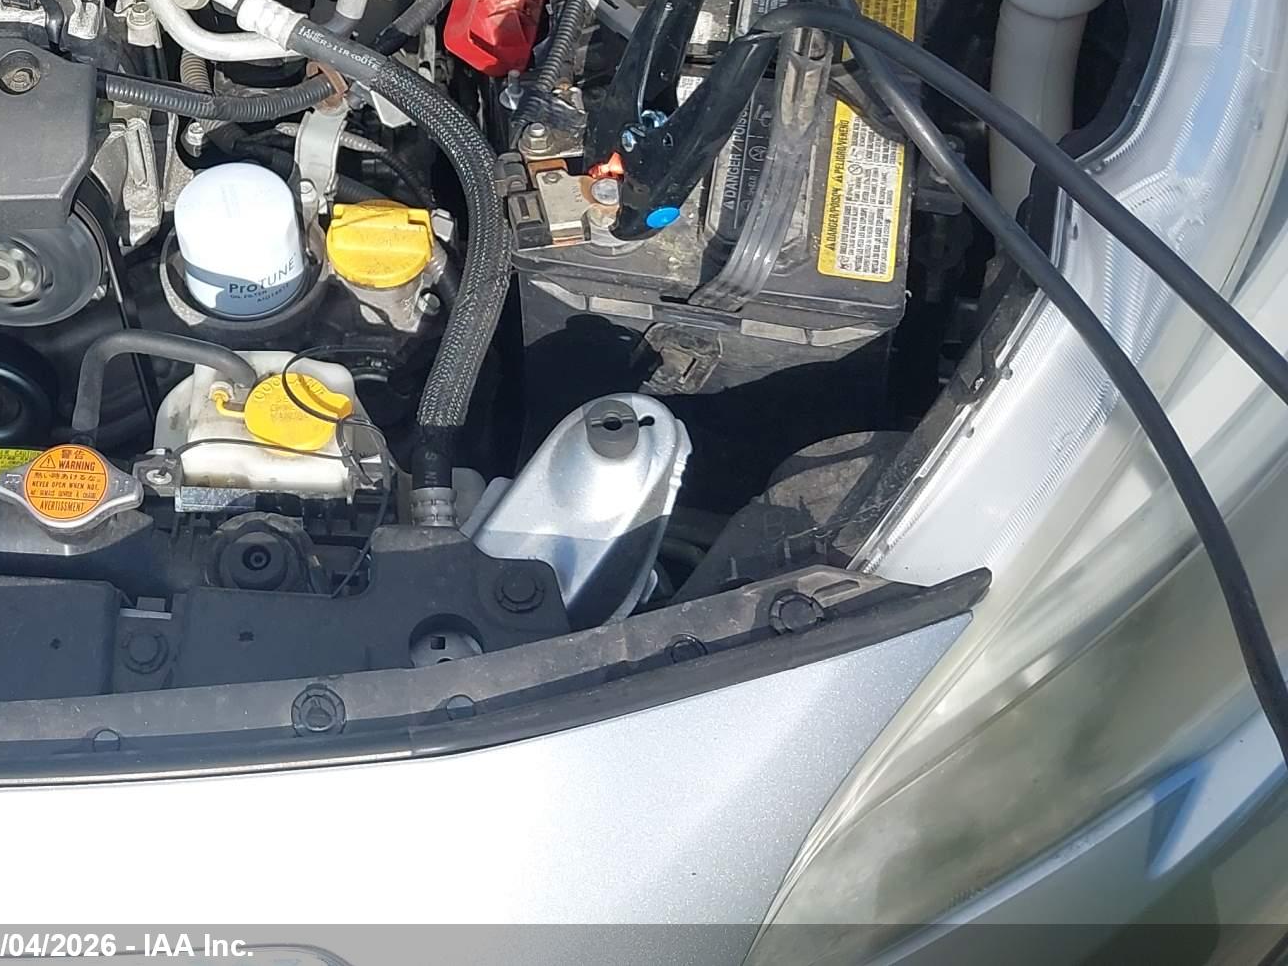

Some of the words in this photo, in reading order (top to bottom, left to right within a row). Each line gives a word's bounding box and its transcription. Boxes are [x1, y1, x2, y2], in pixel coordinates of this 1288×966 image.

[732, 103, 750, 143] POISO
[834, 119, 850, 175] PELIGRO/VENENO
[725, 152, 742, 199] DANGER
[31, 480, 49, 488] NEVER
[51, 481, 66, 489] OPEN
[68, 482, 84, 490] WHEN
[58, 459, 96, 472] WARNING
